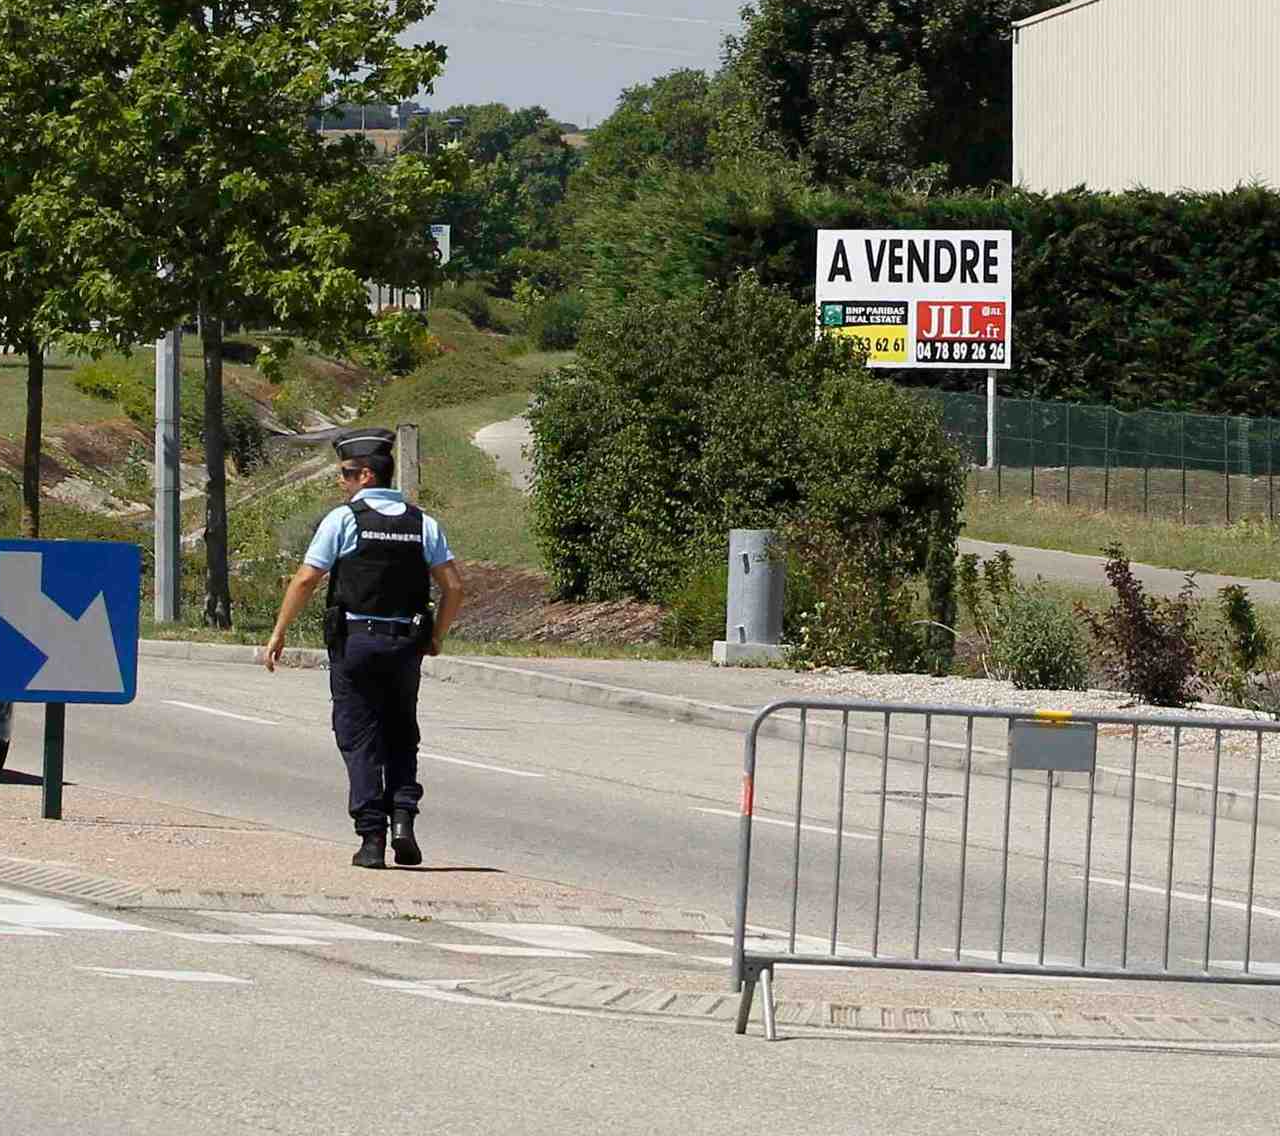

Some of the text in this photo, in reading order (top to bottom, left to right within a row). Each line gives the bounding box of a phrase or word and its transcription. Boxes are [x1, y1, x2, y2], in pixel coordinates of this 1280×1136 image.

[827, 238, 999, 283] A VENDRE
[845, 307, 905, 315] BNP PARIBAS
[845, 315, 903, 323] REAL ESTATE
[875, 338, 889, 352] 62
[893, 338, 905, 352] 61
[917, 342, 1004, 361] 04 78 89 26 26
[361, 530, 422, 543] GENDARMERIE
